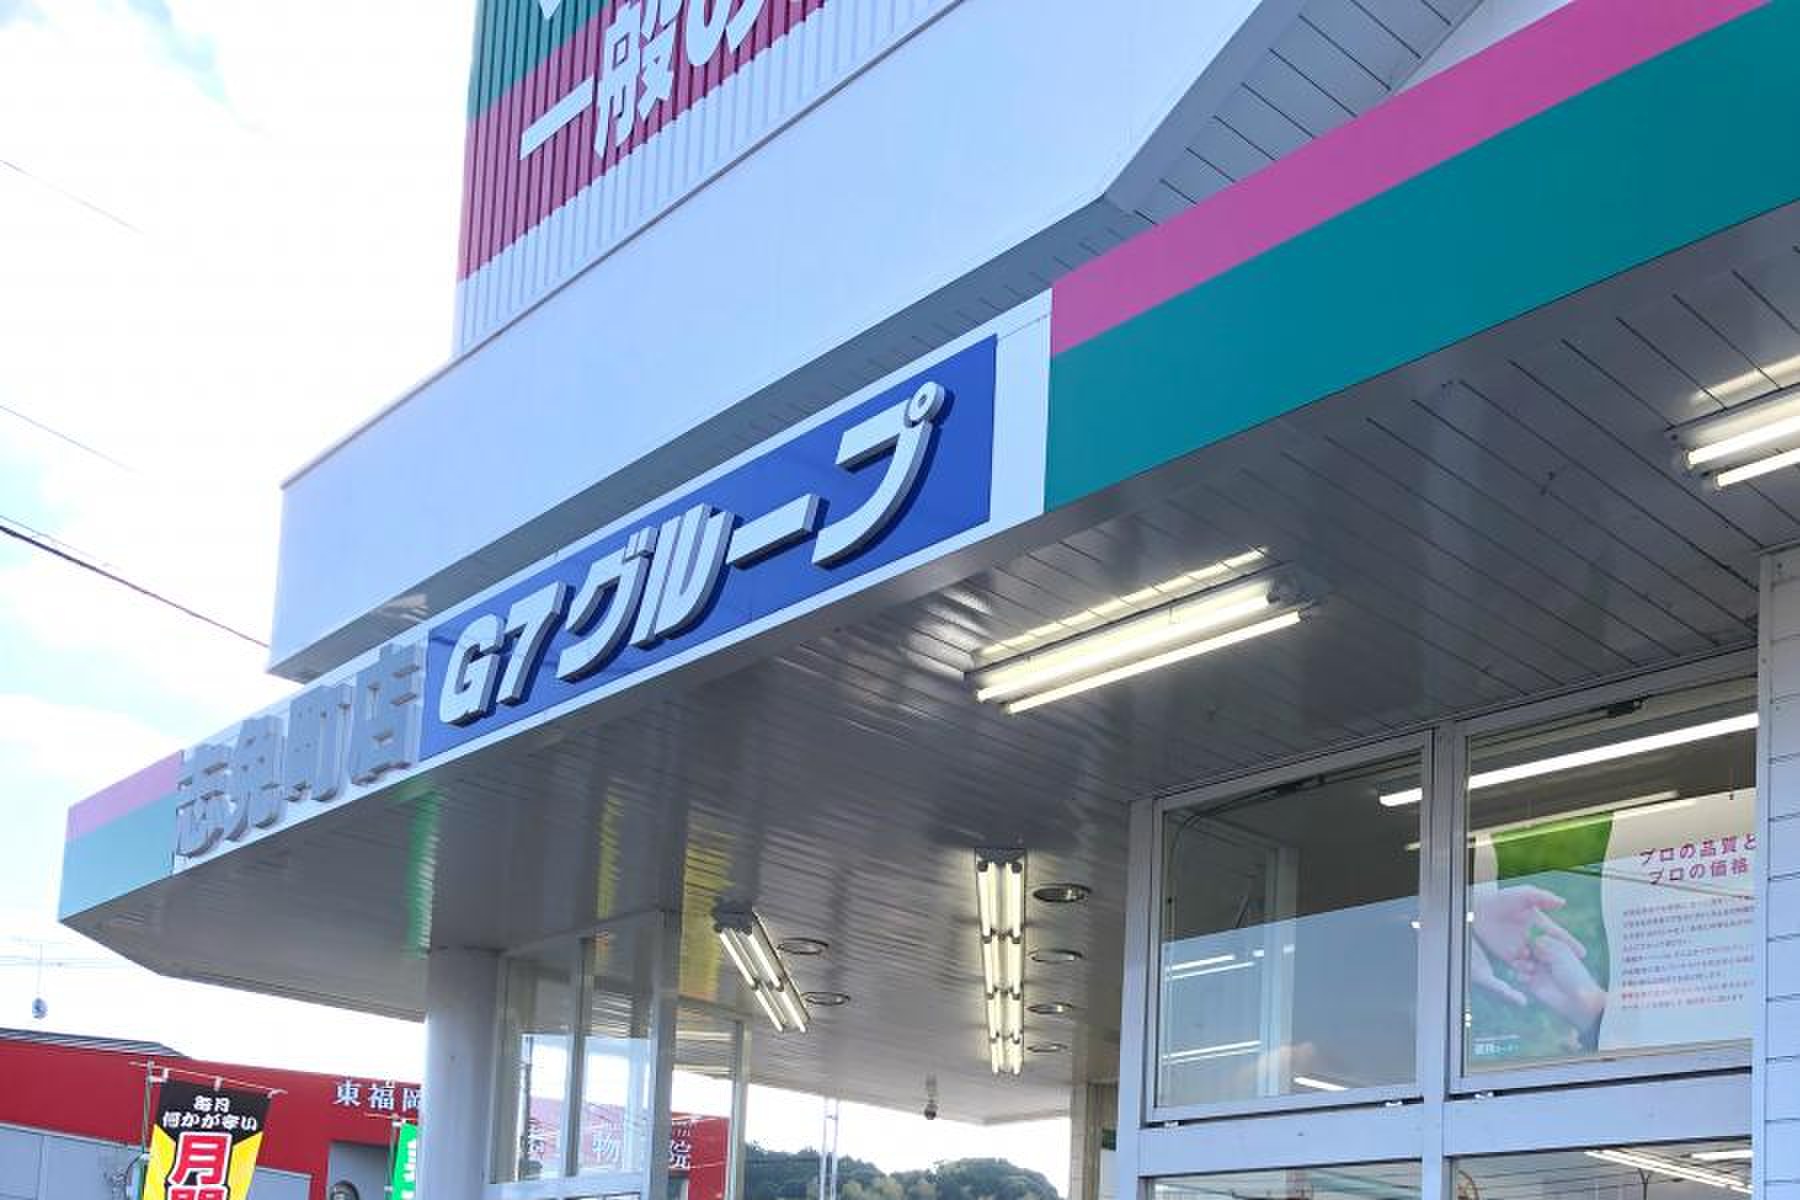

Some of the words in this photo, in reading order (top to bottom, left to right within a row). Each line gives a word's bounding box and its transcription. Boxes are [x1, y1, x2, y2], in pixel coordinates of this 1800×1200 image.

[440, 381, 946, 727] G7グループ
[1639, 833, 1758, 865] プロの品質と
[1650, 858, 1749, 885] プロの価格
[162, 1110, 258, 1131] 何かが安い
